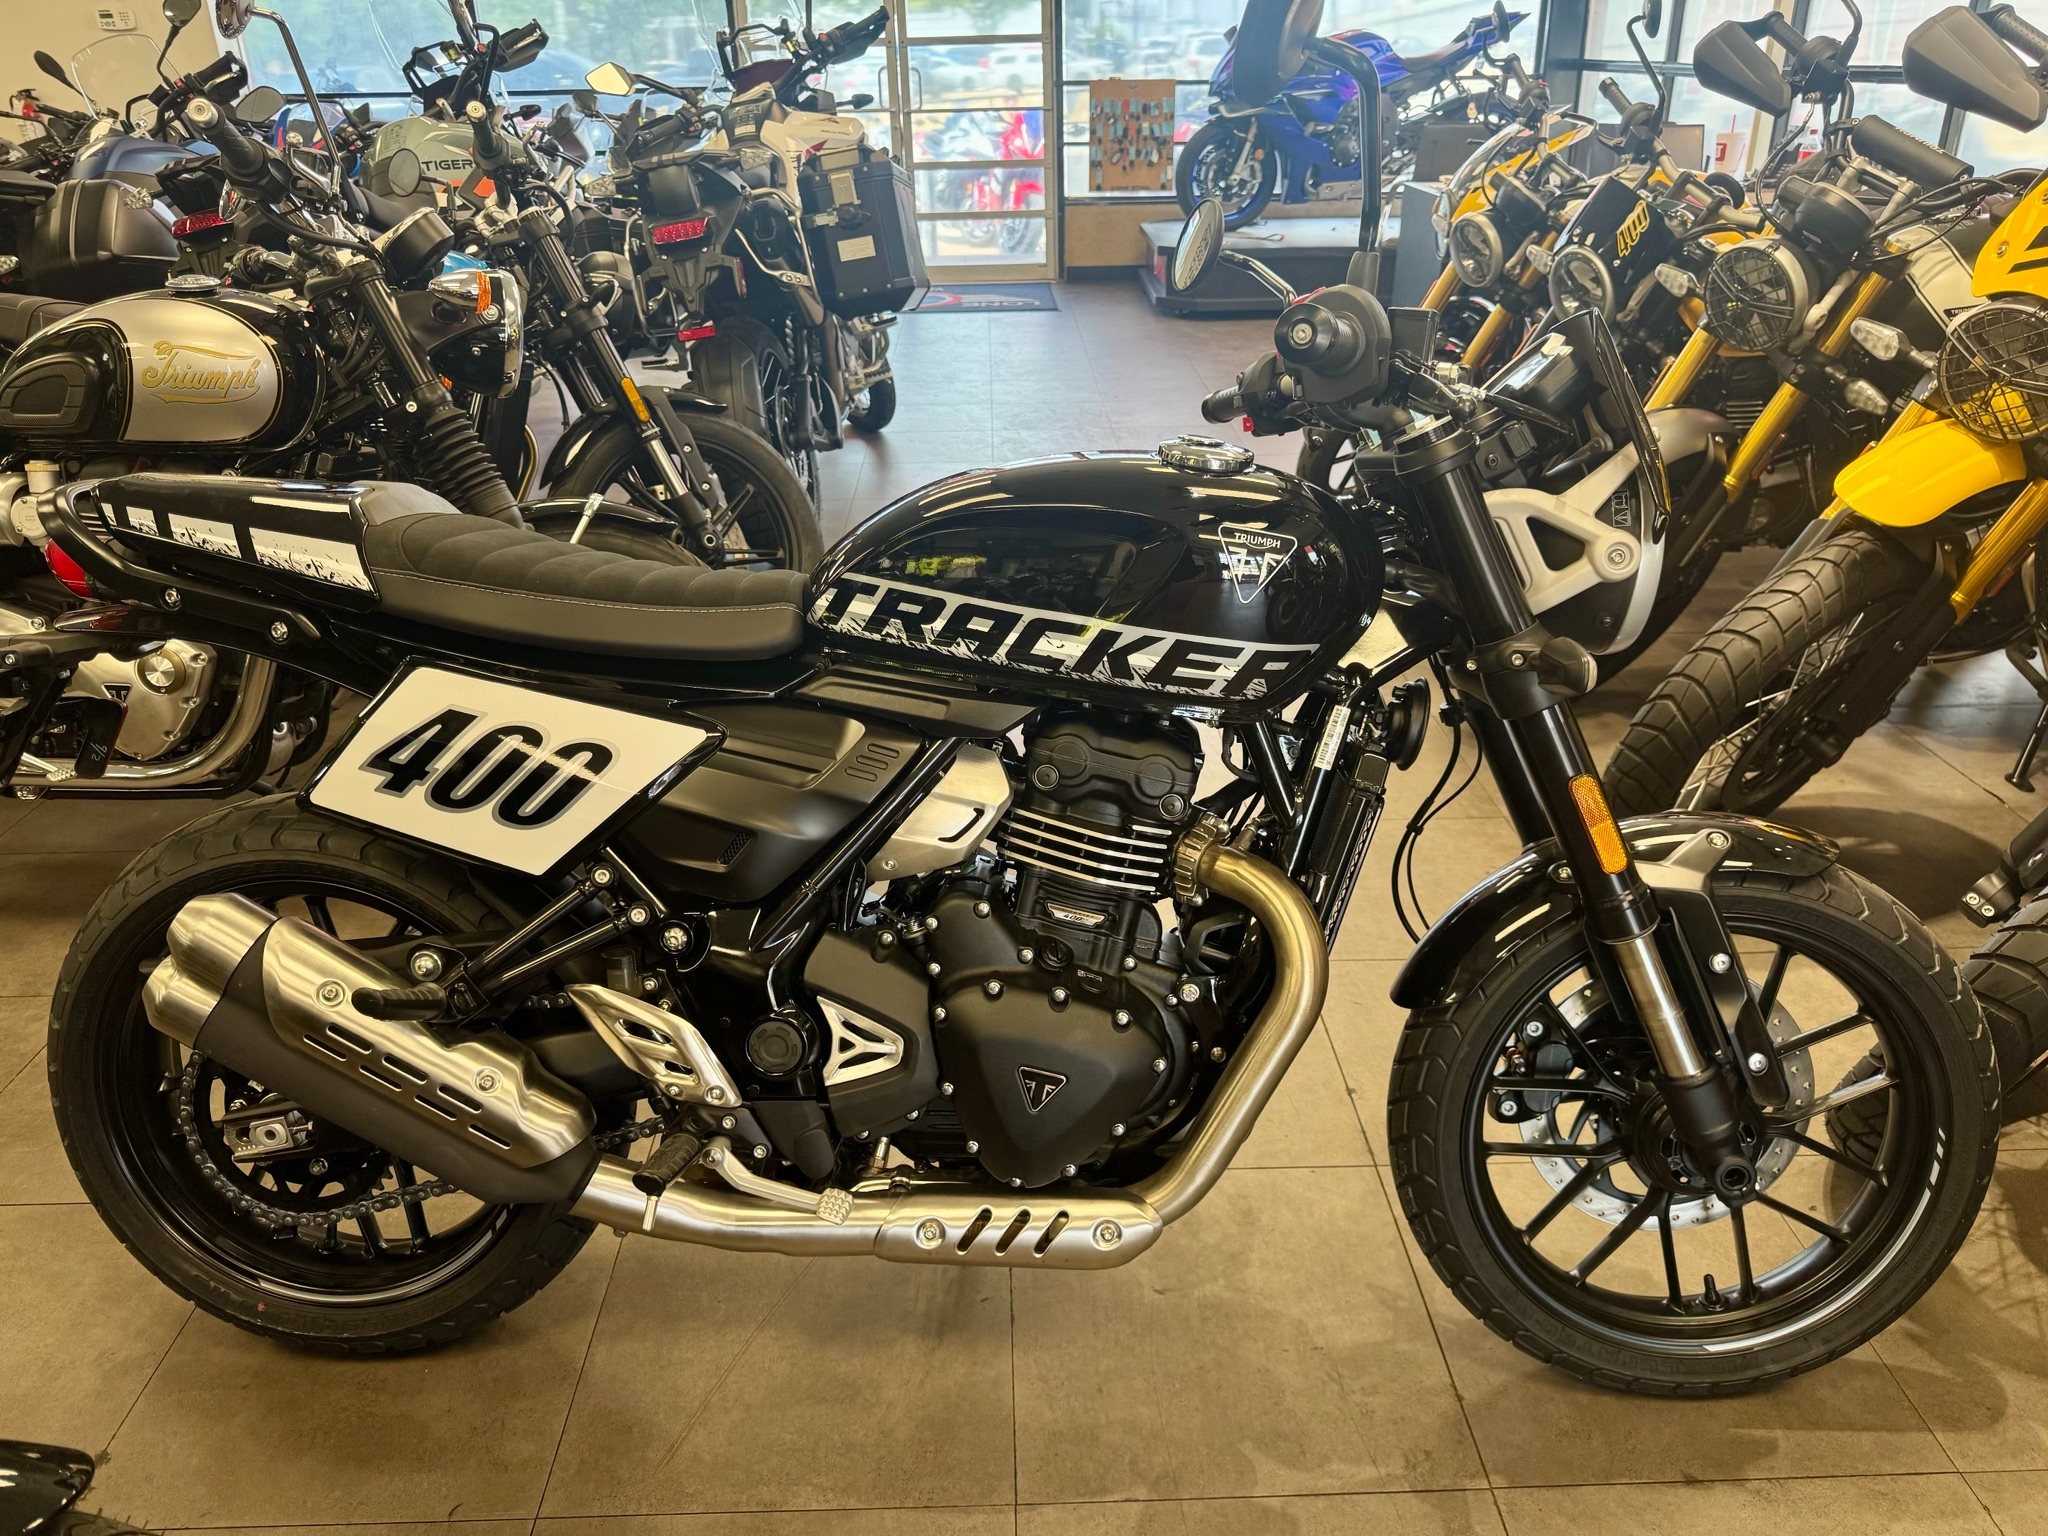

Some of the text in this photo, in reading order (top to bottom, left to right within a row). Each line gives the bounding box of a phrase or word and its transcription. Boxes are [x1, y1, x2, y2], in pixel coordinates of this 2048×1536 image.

[422, 159, 474, 171] TIGER
[1616, 199, 1650, 257] 400
[961, 300, 1041, 308] LONE
[141, 340, 262, 404] Triumph
[1234, 532, 1281, 549] TRIUMPH
[824, 583, 1313, 698] TRACKER
[358, 704, 621, 830] 400
